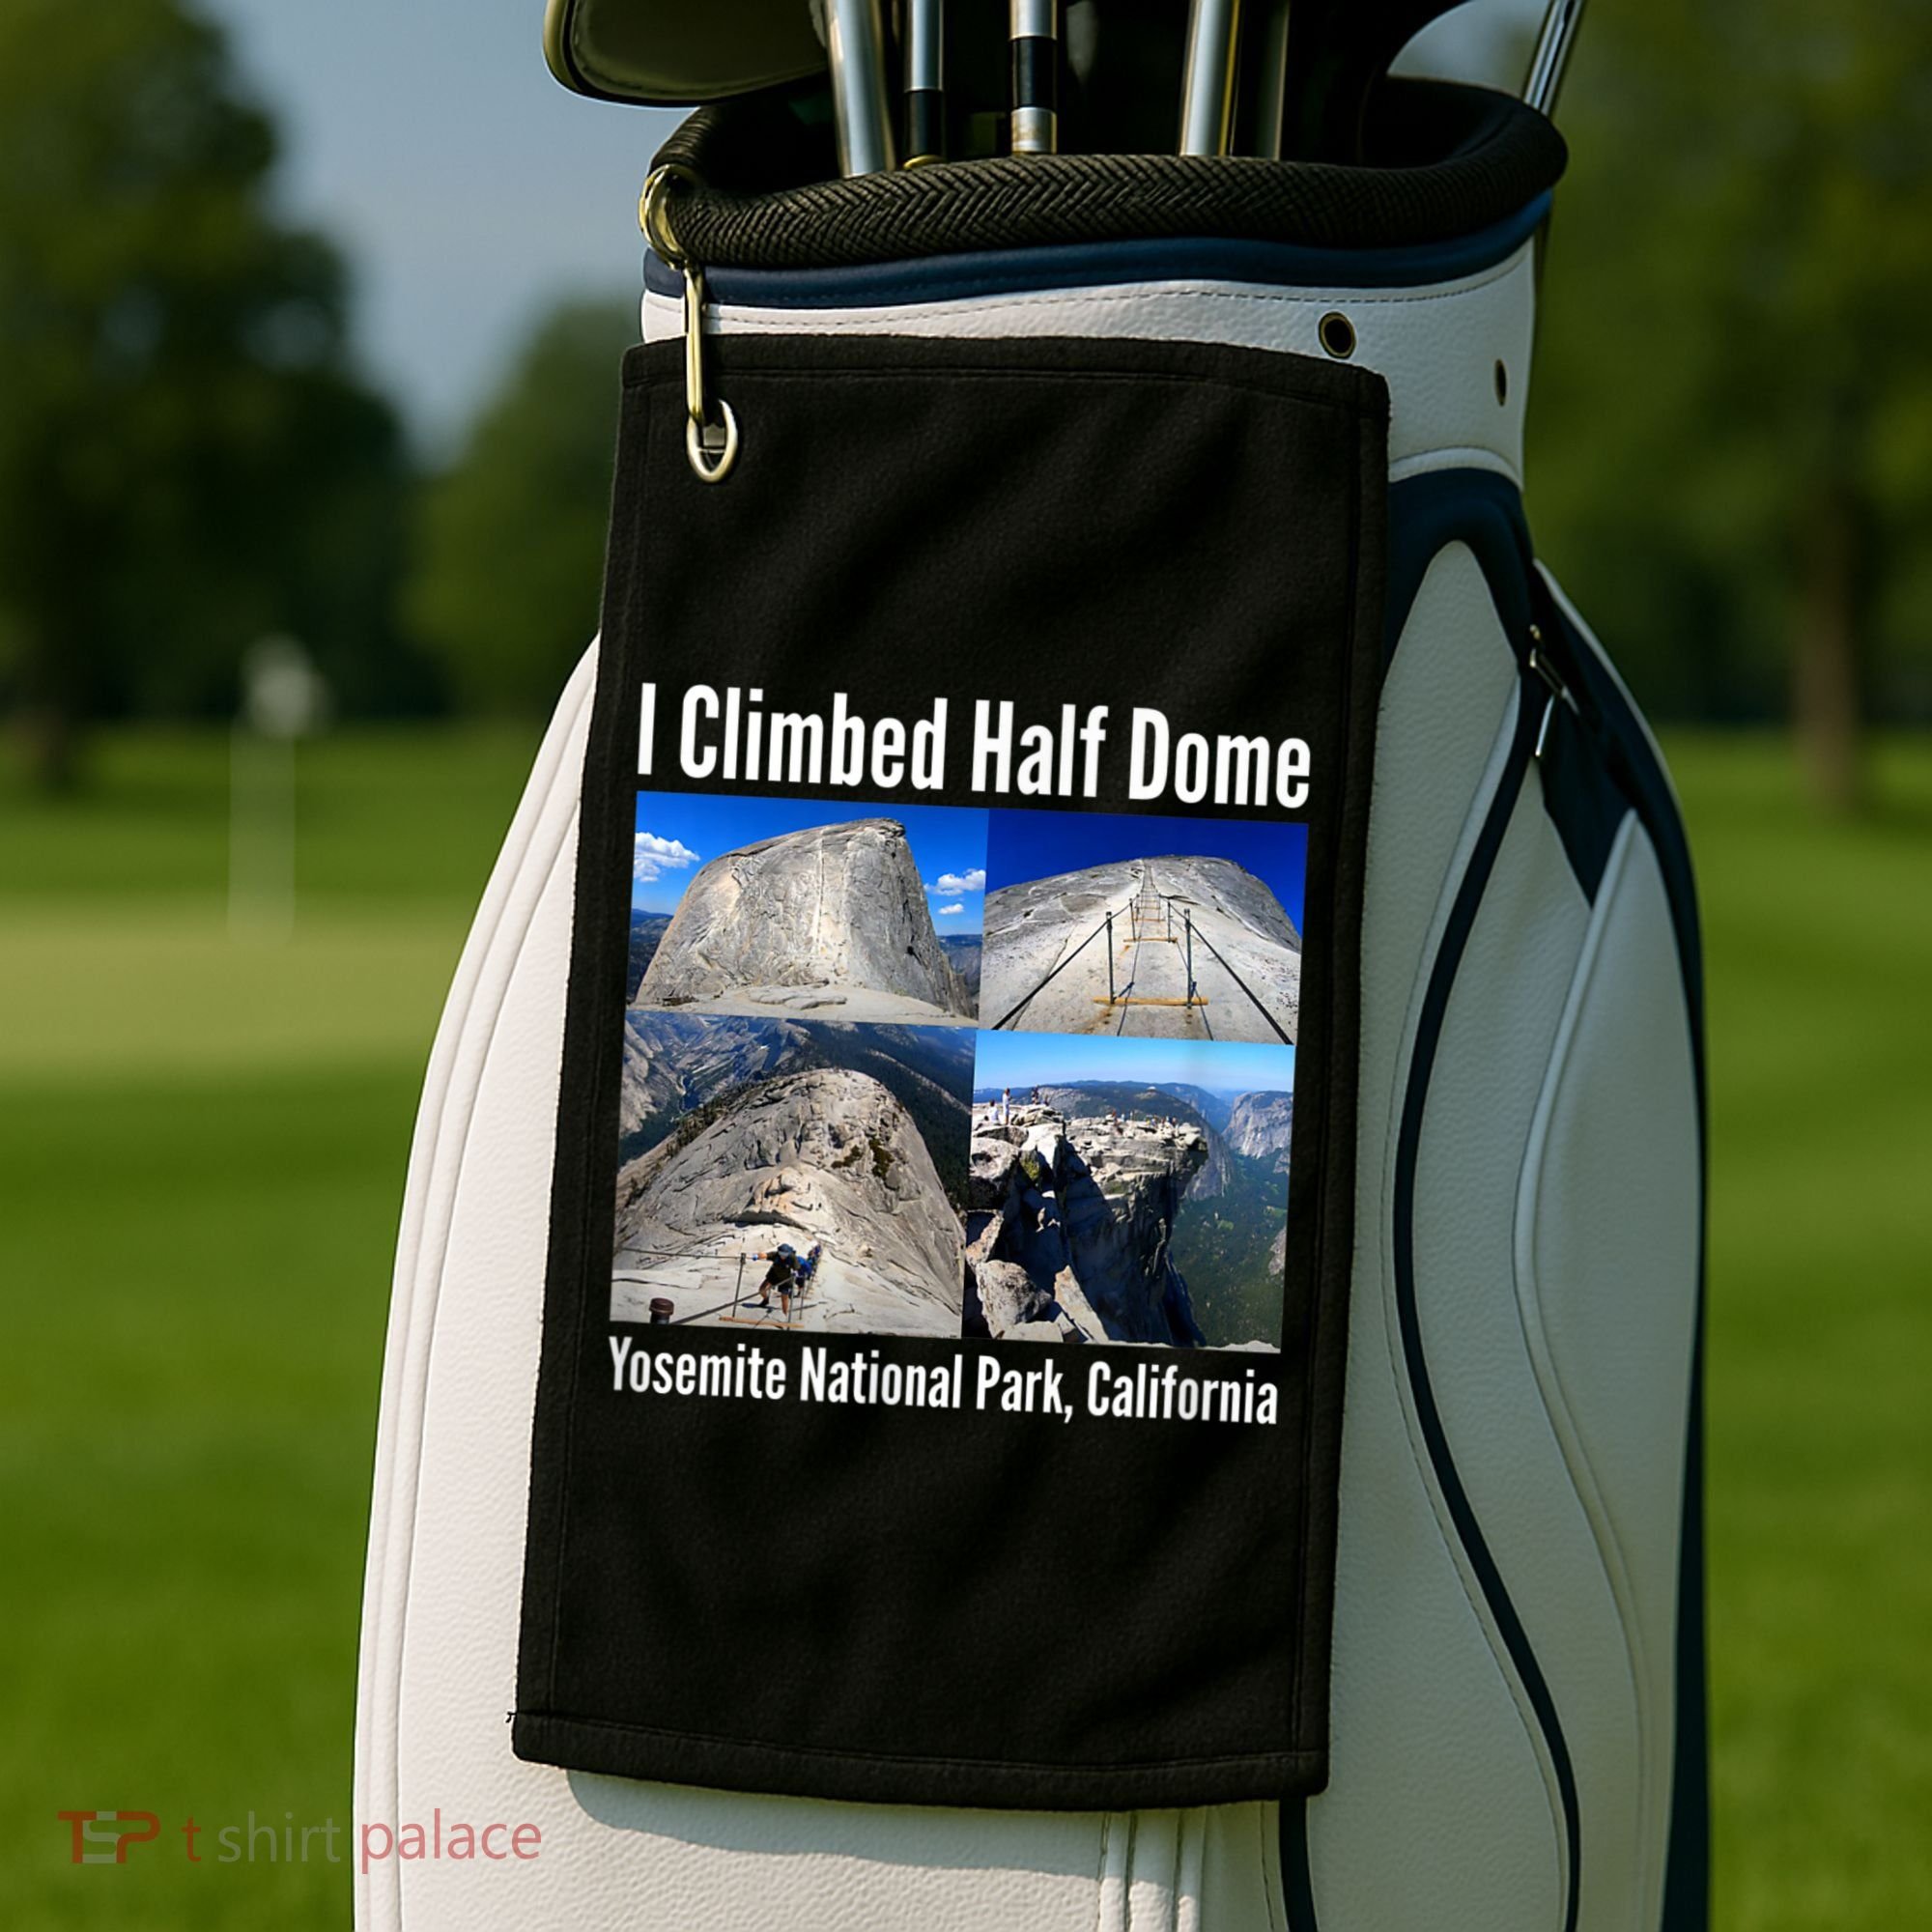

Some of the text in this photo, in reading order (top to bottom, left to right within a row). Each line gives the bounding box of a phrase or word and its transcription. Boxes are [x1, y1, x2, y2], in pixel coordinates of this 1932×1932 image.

[637, 682, 1311, 809] I Climbed Half Dome
[610, 1336, 1278, 1425] Yosemite National Park, California
